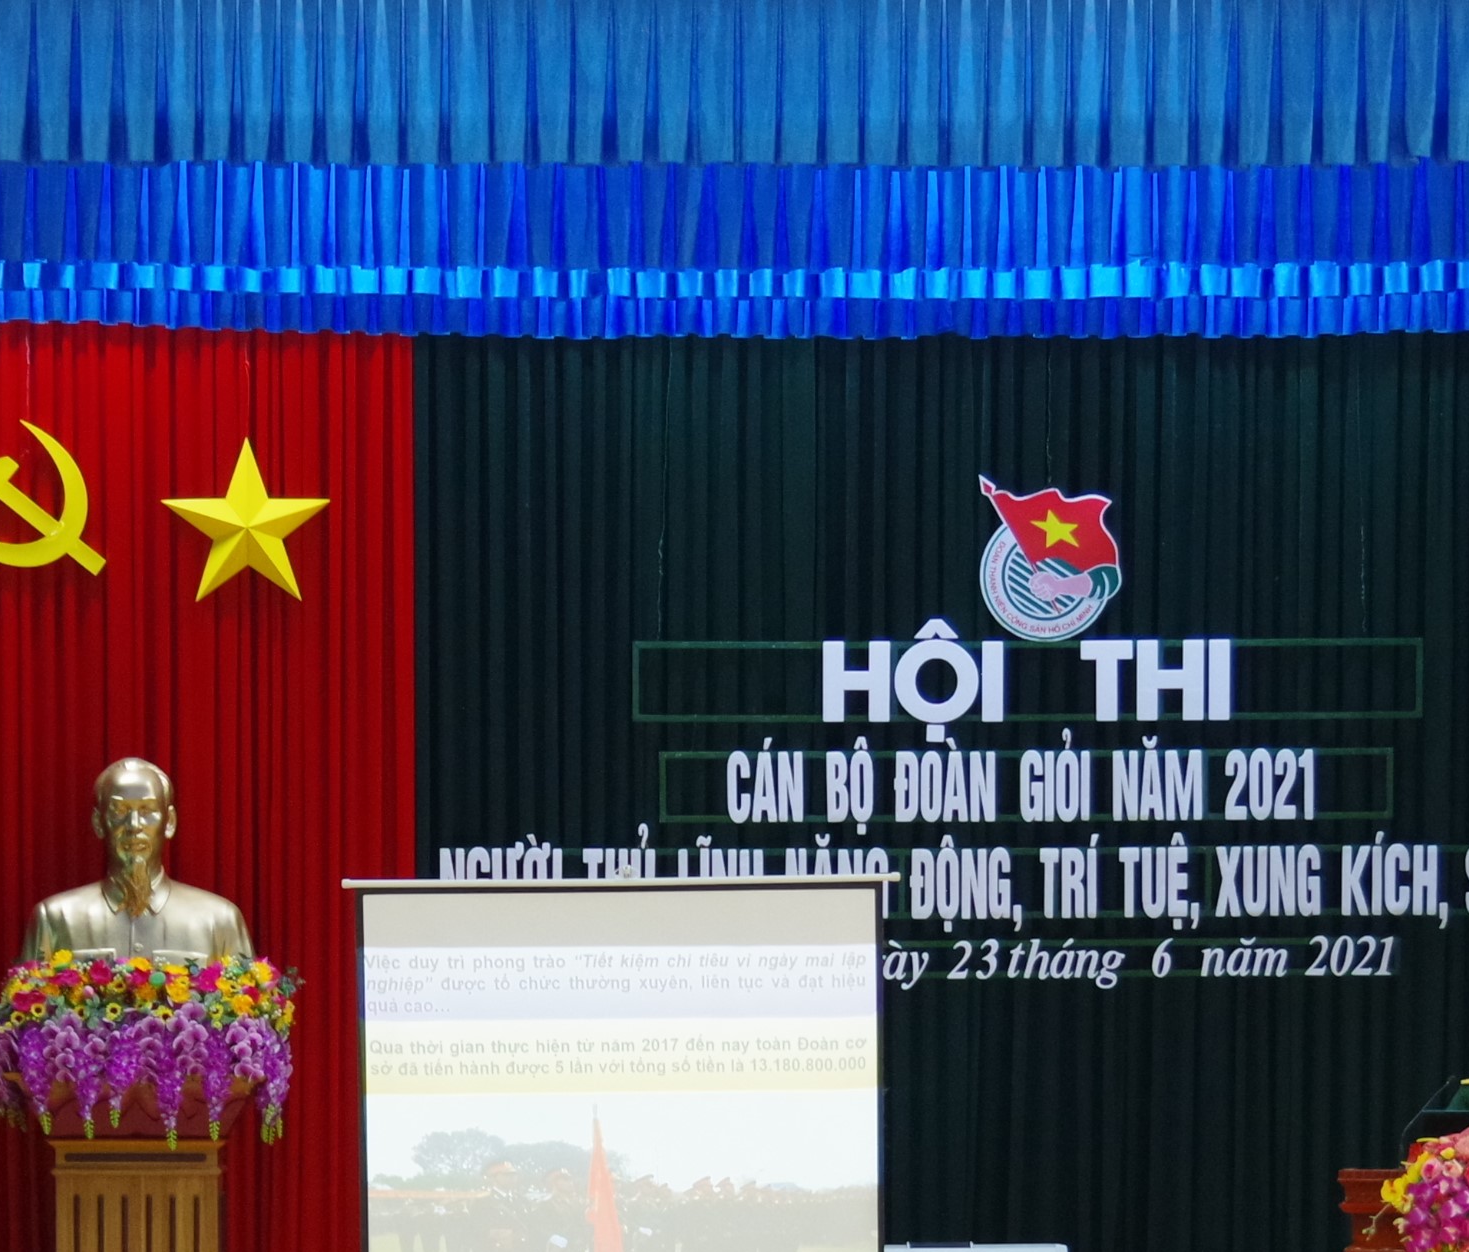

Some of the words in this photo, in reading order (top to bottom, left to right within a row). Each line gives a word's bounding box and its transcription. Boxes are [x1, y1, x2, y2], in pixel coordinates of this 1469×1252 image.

[822, 618, 1003, 742] HỘI
[1080, 638, 1231, 723] THI
[726, 738, 804, 823] CÁN
[826, 736, 875, 836] BỘ
[894, 736, 996, 823] ĐOÀN
[1019, 728, 1091, 823] GIỎI
[1112, 736, 1203, 821] NĂM
[1224, 748, 1316, 821] 2021
[909, 836, 1024, 935] ĐỘNG,
[1040, 834, 1100, 918] TRÍ
[1118, 832, 1200, 932] TUỆ,
[1214, 844, 1322, 920] XUNG
[1341, 830, 1450, 930] KÍCH,
[365, 955, 401, 971] Việc
[409, 955, 439, 972] duy
[447, 955, 465, 970] trì
[473, 955, 525, 972] phong
[533, 955, 565, 969] trào
[621, 953, 659, 971] kiệm
[667, 953, 691, 968] chi
[699, 953, 729, 967] tiêu
[758, 953, 798, 970] ngày
[805, 953, 834, 967] mai
[842, 952, 866, 969] lập
[882, 939, 929, 990] ày
[948, 940, 998, 980] 23
[1006, 938, 1125, 990] tháng
[1151, 938, 1173, 979] 6
[1200, 938, 1288, 978] năm
[1304, 935, 1396, 976] 2021
[370, 1040, 403, 1055] Qua
[410, 1040, 444, 1055] thời
[450, 1041, 484, 1057] gian
[491, 1040, 529, 1057] thực
[536, 1039, 570, 1056] hiện
[577, 1038, 595, 1053] từ
[601, 1039, 635, 1052] năm
[642, 1038, 678, 1052] 2017
[685, 1034, 715, 1051] đến
[722, 1039, 749, 1054] nay
[757, 1037, 791, 1051] toàn
[798, 1037, 839, 1050] Đoàn
[845, 1036, 866, 1049] cơ
